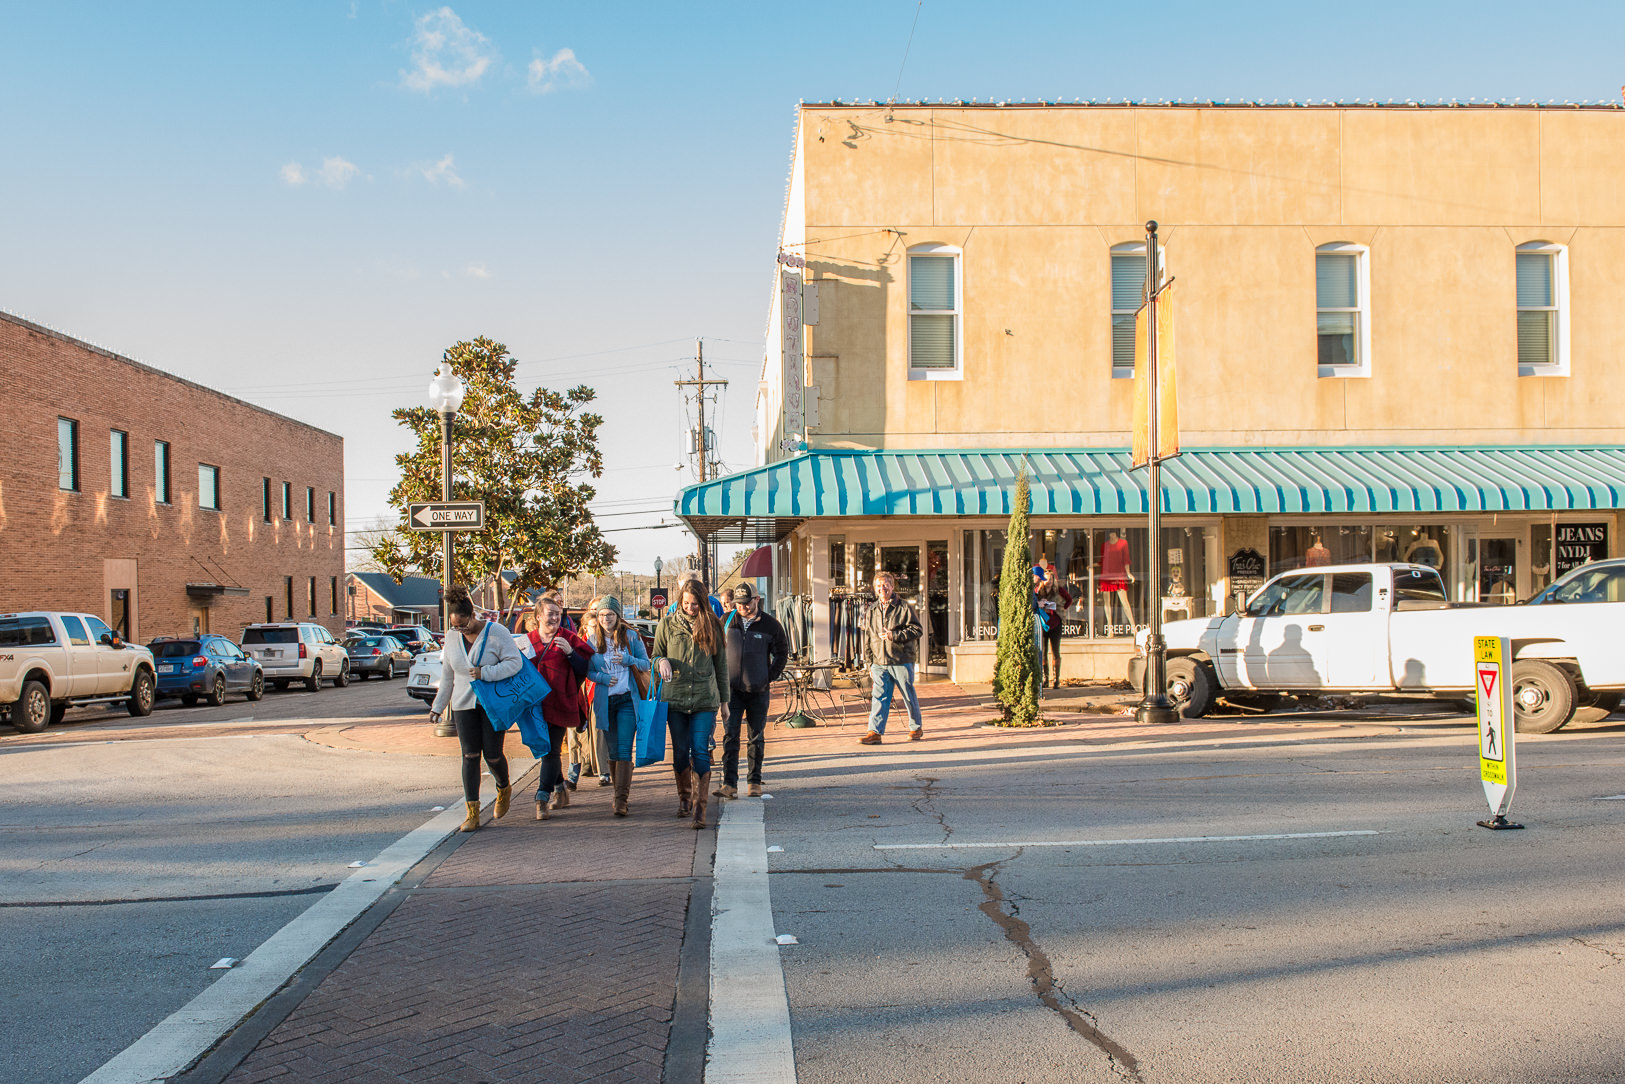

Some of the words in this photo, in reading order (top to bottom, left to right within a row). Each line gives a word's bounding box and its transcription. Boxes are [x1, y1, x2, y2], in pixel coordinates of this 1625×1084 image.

[432, 511, 451, 521] ONE
[454, 511, 474, 521] WAY
[1558, 527, 1604, 542] JEANS
[1558, 546, 1591, 558] NYDJ
[1557, 561, 1562, 569] 7
[1562, 561, 1571, 569] for
[972, 625, 998, 636] KEND
[1061, 624, 1082, 635] ERRY
[1104, 624, 1124, 635] FREE
[1125, 624, 1148, 635] PEOP
[1478, 639, 1496, 649] STATE
[1481, 651, 1493, 660] LAW
[1486, 709, 1493, 718] TO
